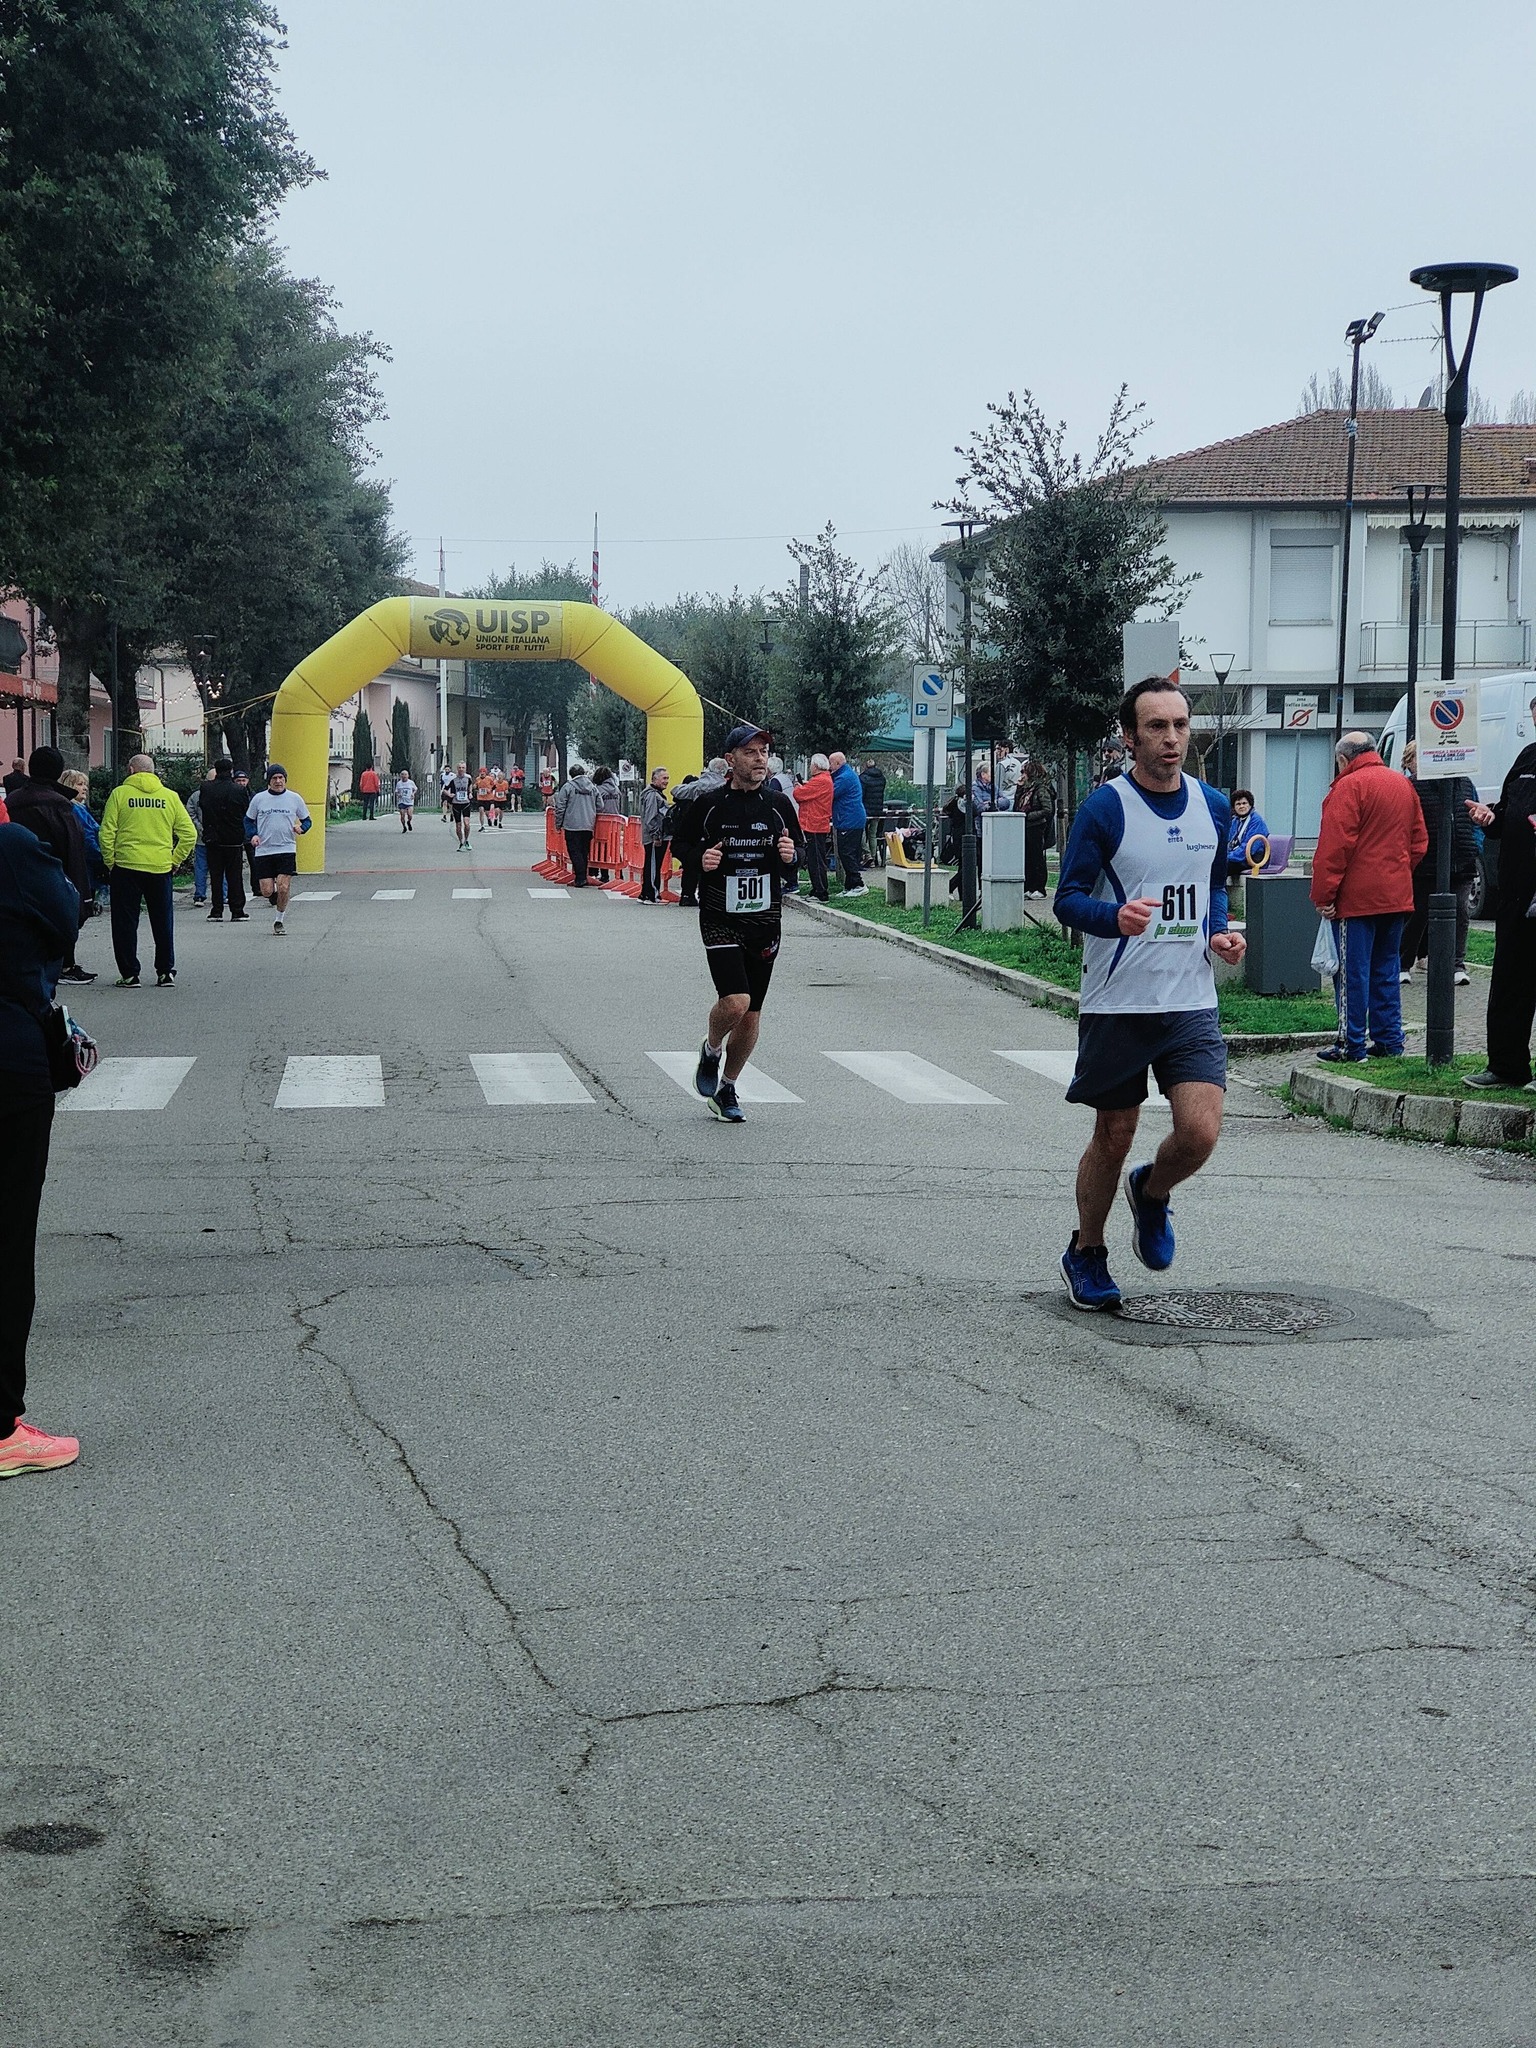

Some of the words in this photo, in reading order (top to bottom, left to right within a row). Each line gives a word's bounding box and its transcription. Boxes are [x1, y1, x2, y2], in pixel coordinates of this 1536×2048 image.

[475, 609, 550, 634] UISP
[475, 635, 509, 643] UNIONE
[512, 635, 550, 644] ITALIANA
[128, 797, 166, 809] GIUDICE
[737, 877, 763, 900] 501
[1162, 884, 1197, 921] 611
